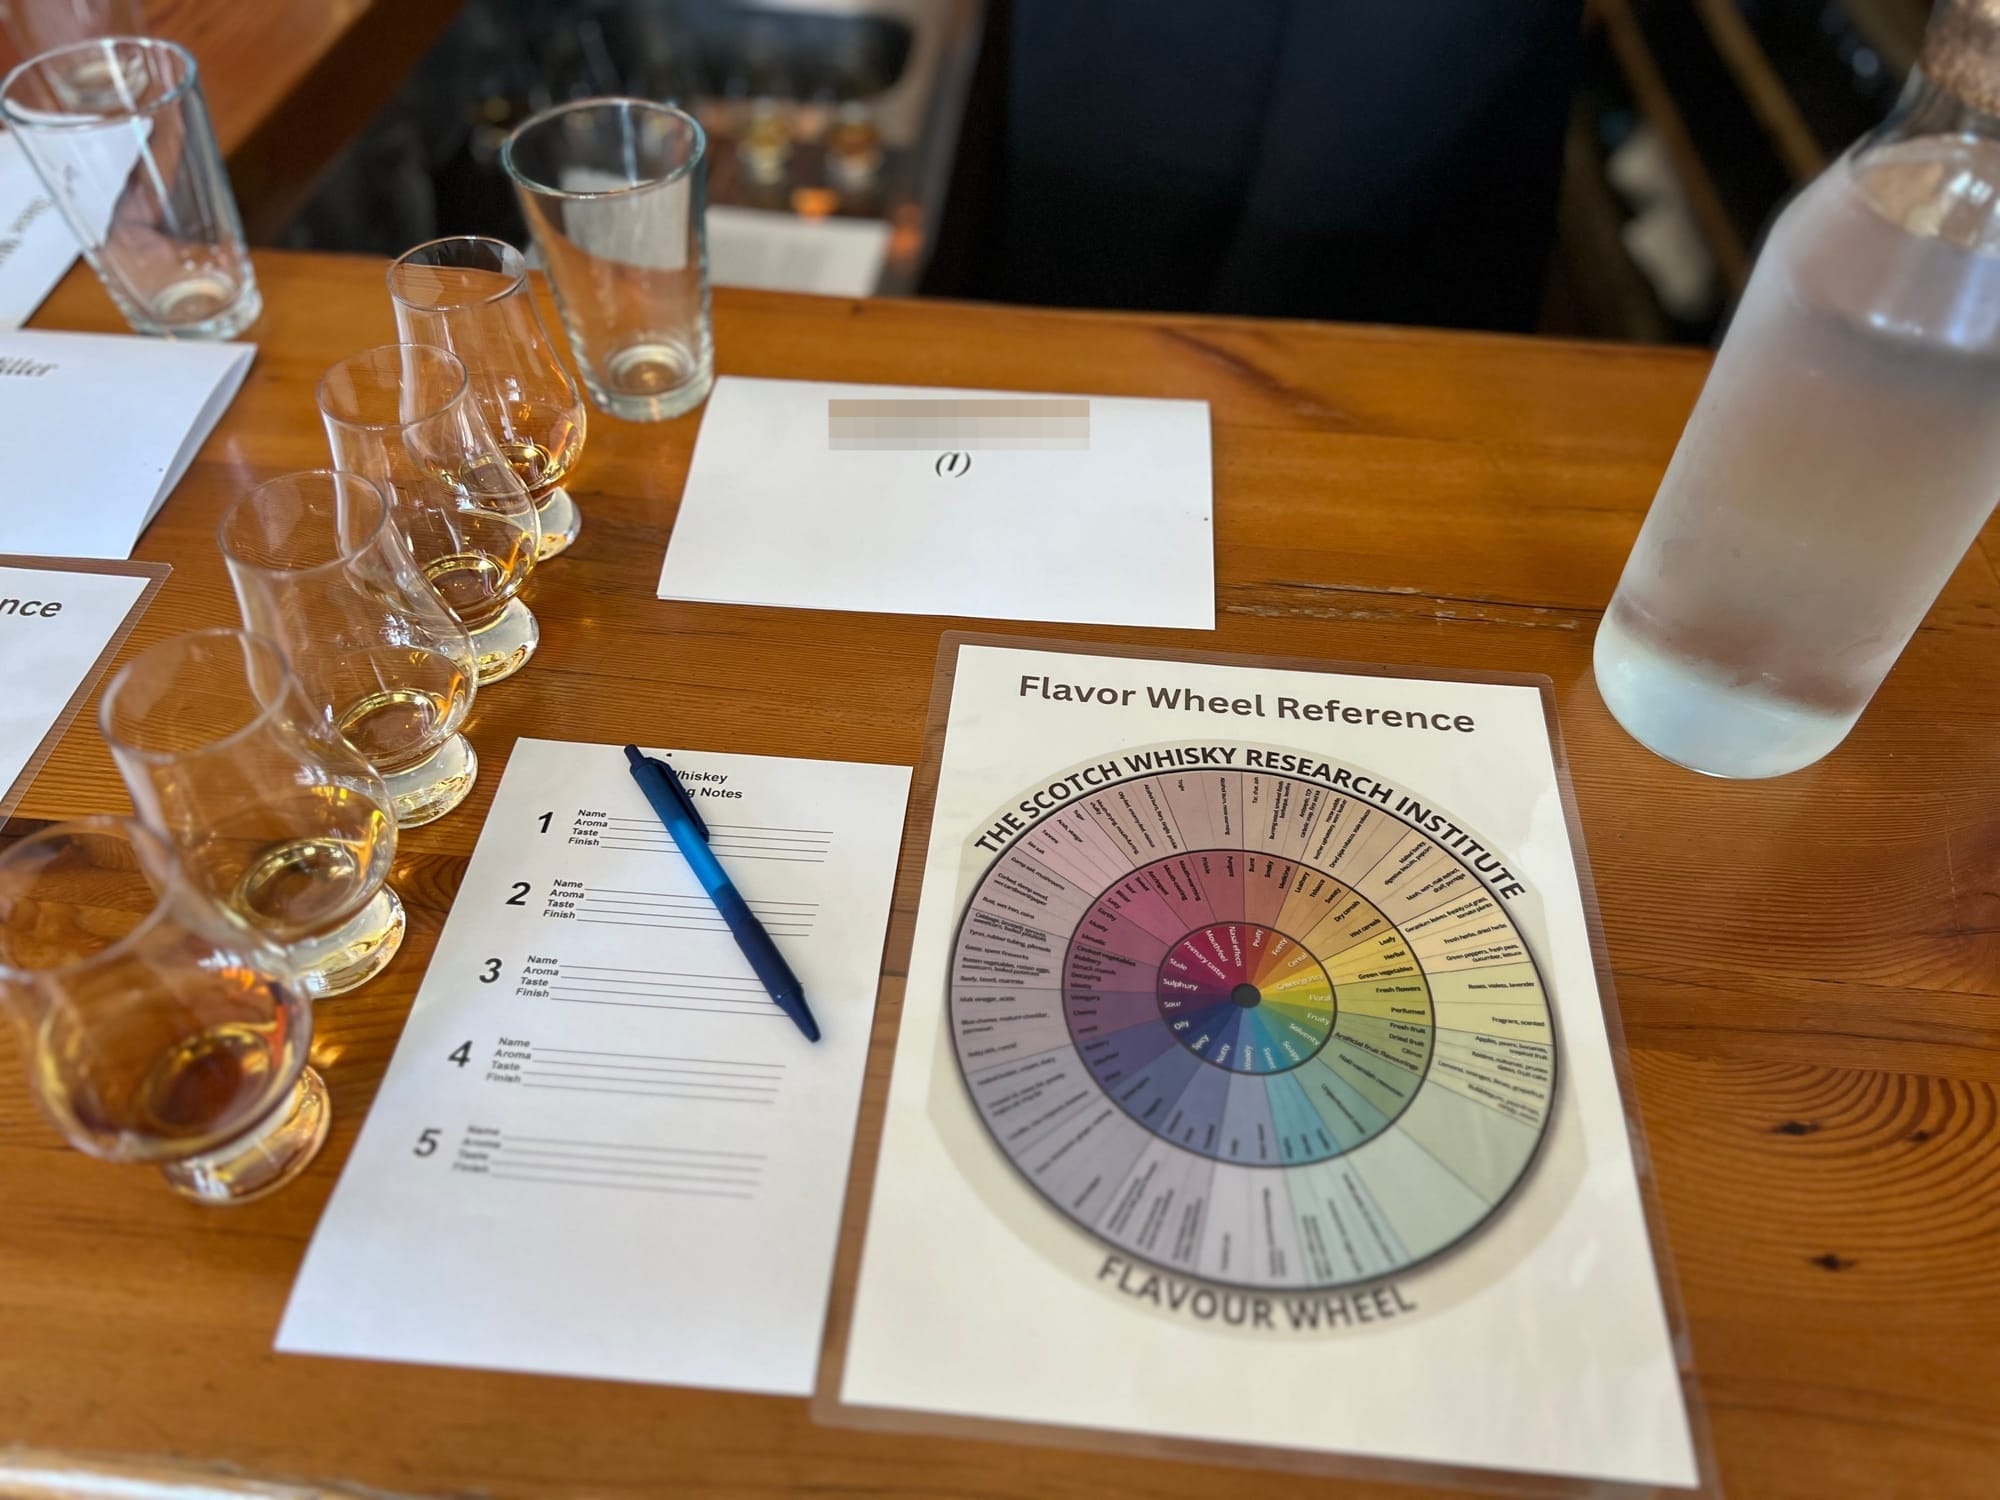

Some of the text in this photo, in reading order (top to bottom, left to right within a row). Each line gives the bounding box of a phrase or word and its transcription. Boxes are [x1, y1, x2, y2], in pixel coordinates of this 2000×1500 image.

[1019, 674, 1476, 733] Flavor Wheel Reference
[700, 787, 743, 799] Notes
[578, 809, 607, 819] Name
[537, 811, 554, 833] 1
[574, 818, 608, 828] Aroma
[974, 812, 1026, 852] THE
[1020, 762, 1123, 819] SCOTCH
[1124, 747, 1237, 773] WHISKY
[1245, 748, 1394, 804] RESEARCH
[1395, 797, 1526, 900] INSTITUTE
[572, 827, 599, 837] Taste
[568, 836, 600, 847] Finish
[553, 879, 583, 890] Name
[506, 881, 531, 905] 2
[549, 889, 585, 900] Aroma
[547, 899, 575, 909] Taste
[543, 909, 576, 920] Finish
[527, 955, 558, 965] Name
[479, 957, 503, 984] 3
[523, 966, 559, 976] Aroma
[520, 977, 549, 987] Taste
[1162, 977, 1199, 991] Sulphury
[515, 988, 550, 998] Finish
[447, 1039, 473, 1068] 4
[413, 1126, 442, 1158] 5
[1096, 1255, 1418, 1331] FLAVOUR WHEEL
